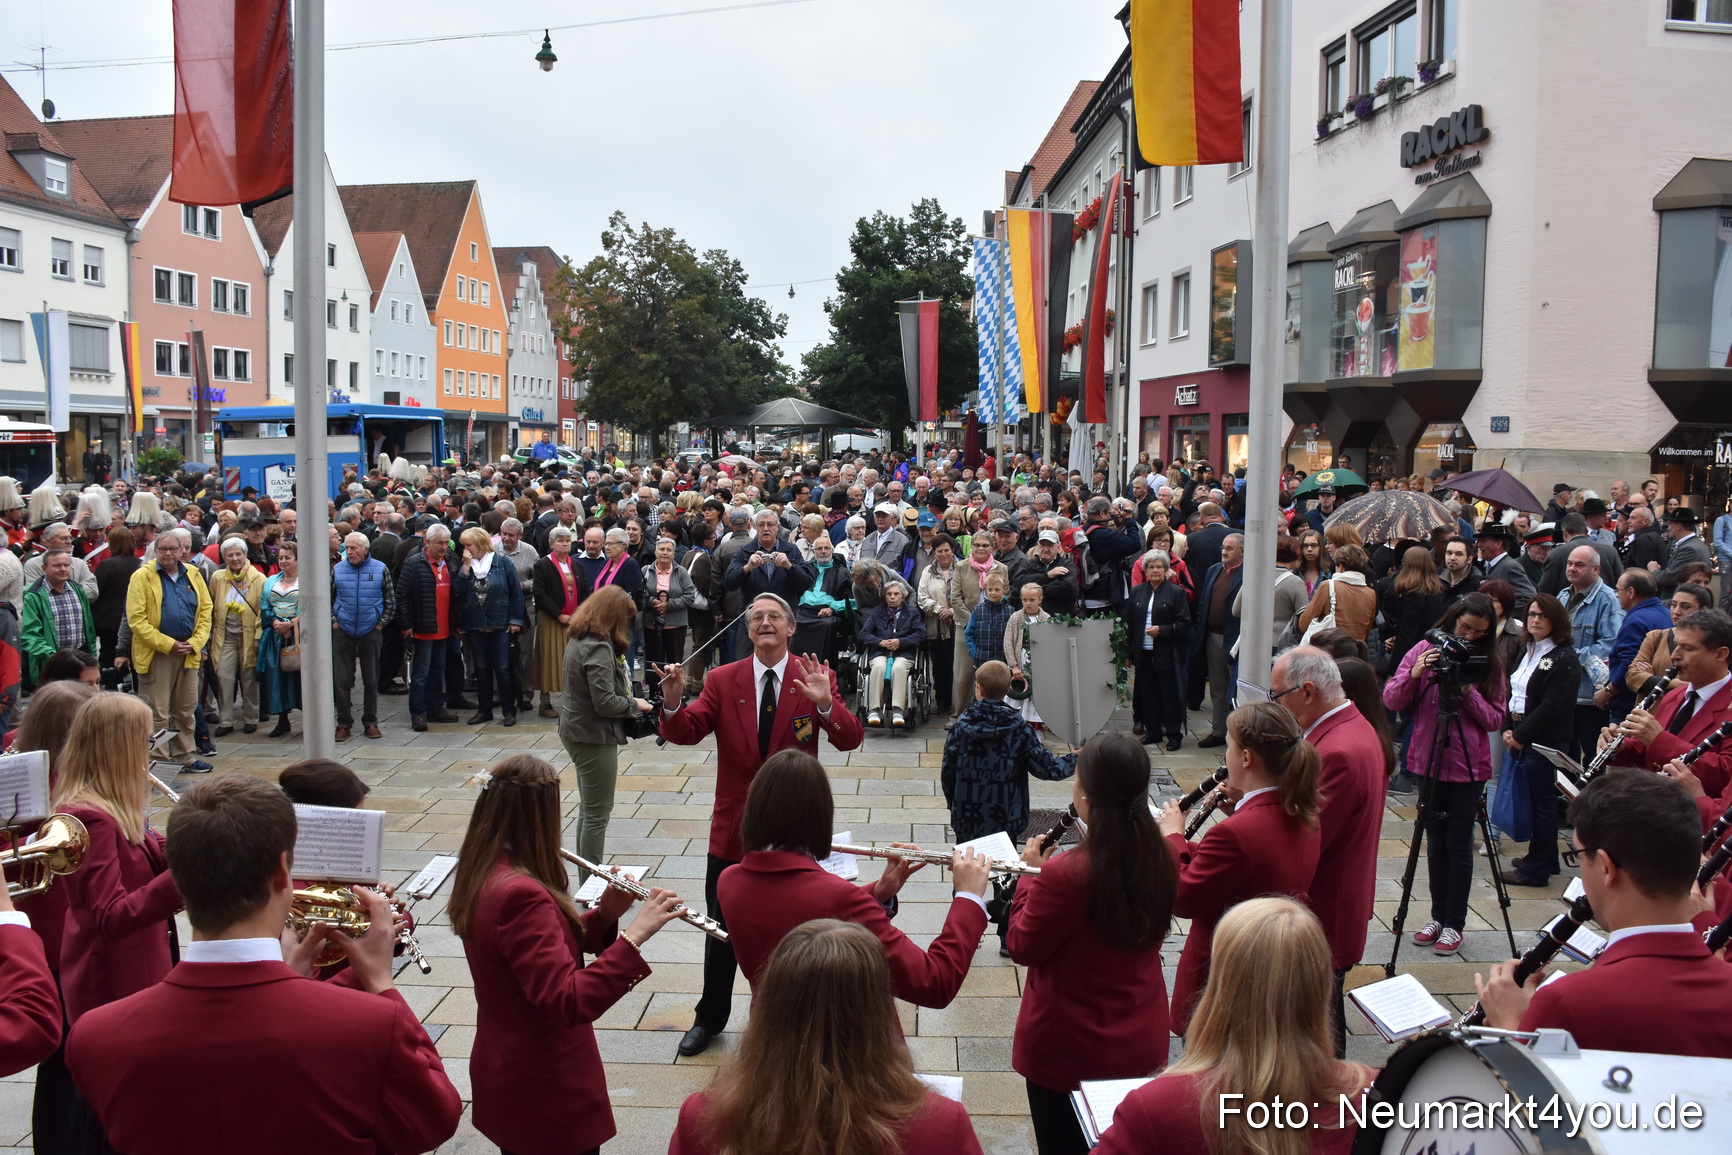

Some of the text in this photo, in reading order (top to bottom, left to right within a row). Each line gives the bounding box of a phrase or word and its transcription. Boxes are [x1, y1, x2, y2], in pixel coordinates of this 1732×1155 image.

[1400, 104, 1489, 168] RACKL
[1415, 151, 1481, 185] am Rathaus
[1334, 266, 1355, 289] RACKL
[1173, 384, 1197, 405] Achatz
[1437, 444, 1454, 457] RACKL
[1659, 447, 1702, 455] Willkommen
[1704, 448, 1713, 456] im
